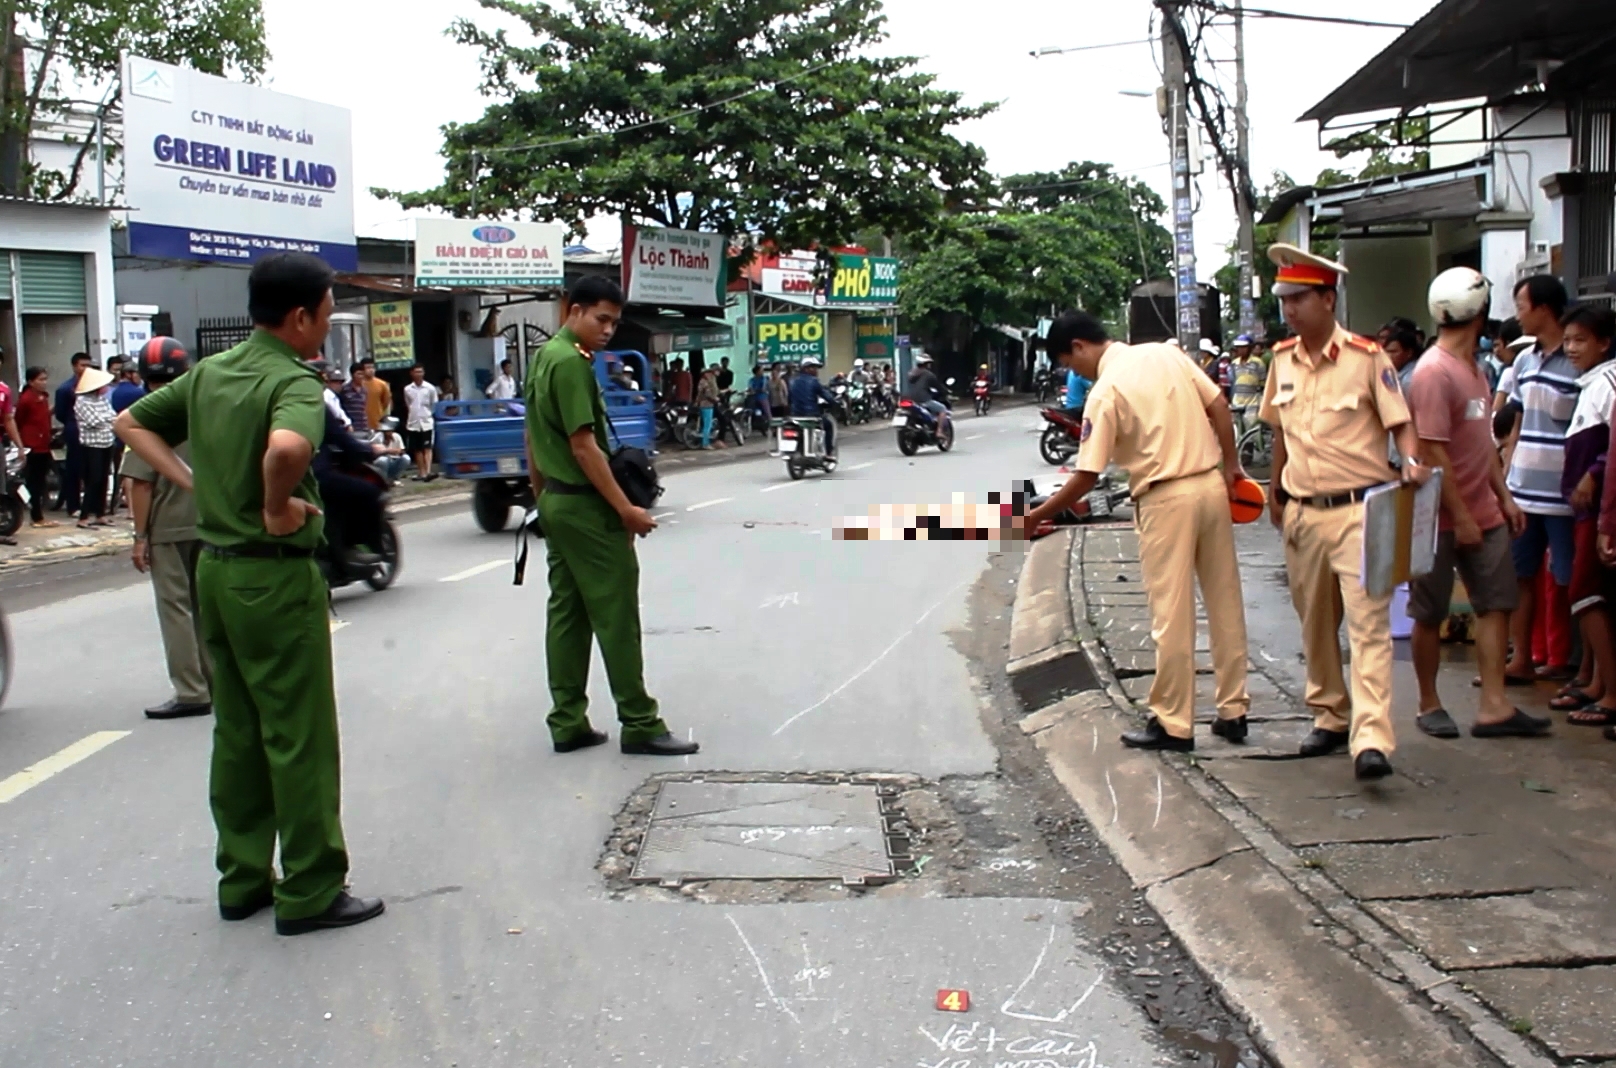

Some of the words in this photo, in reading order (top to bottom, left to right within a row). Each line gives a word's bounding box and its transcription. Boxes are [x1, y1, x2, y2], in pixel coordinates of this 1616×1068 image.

[217, 115, 244, 131] TNHH
[247, 119, 264, 135] BẤT
[267, 125, 293, 141] ĐỘNG
[296, 129, 313, 145] SẢN
[153, 134, 230, 172] GREEN
[237, 149, 277, 180] LIFE
[283, 158, 336, 188] LAND
[179, 176, 216, 195] Chuyên
[219, 181, 231, 194] tư
[233, 183, 249, 198] vấn
[251, 189, 269, 200] mua
[273, 189, 289, 203] bán
[291, 192, 306, 206] nhà
[436, 243, 466, 258] HÀN
[639, 245, 666, 270] Lộc
[669, 248, 709, 270] Thành
[832, 258, 871, 297] PHỞ
[874, 263, 896, 284] NGỌC
[759, 315, 823, 342] PHỞ
[779, 343, 819, 353] NGỌC
[943, 992, 961, 1010] 4
